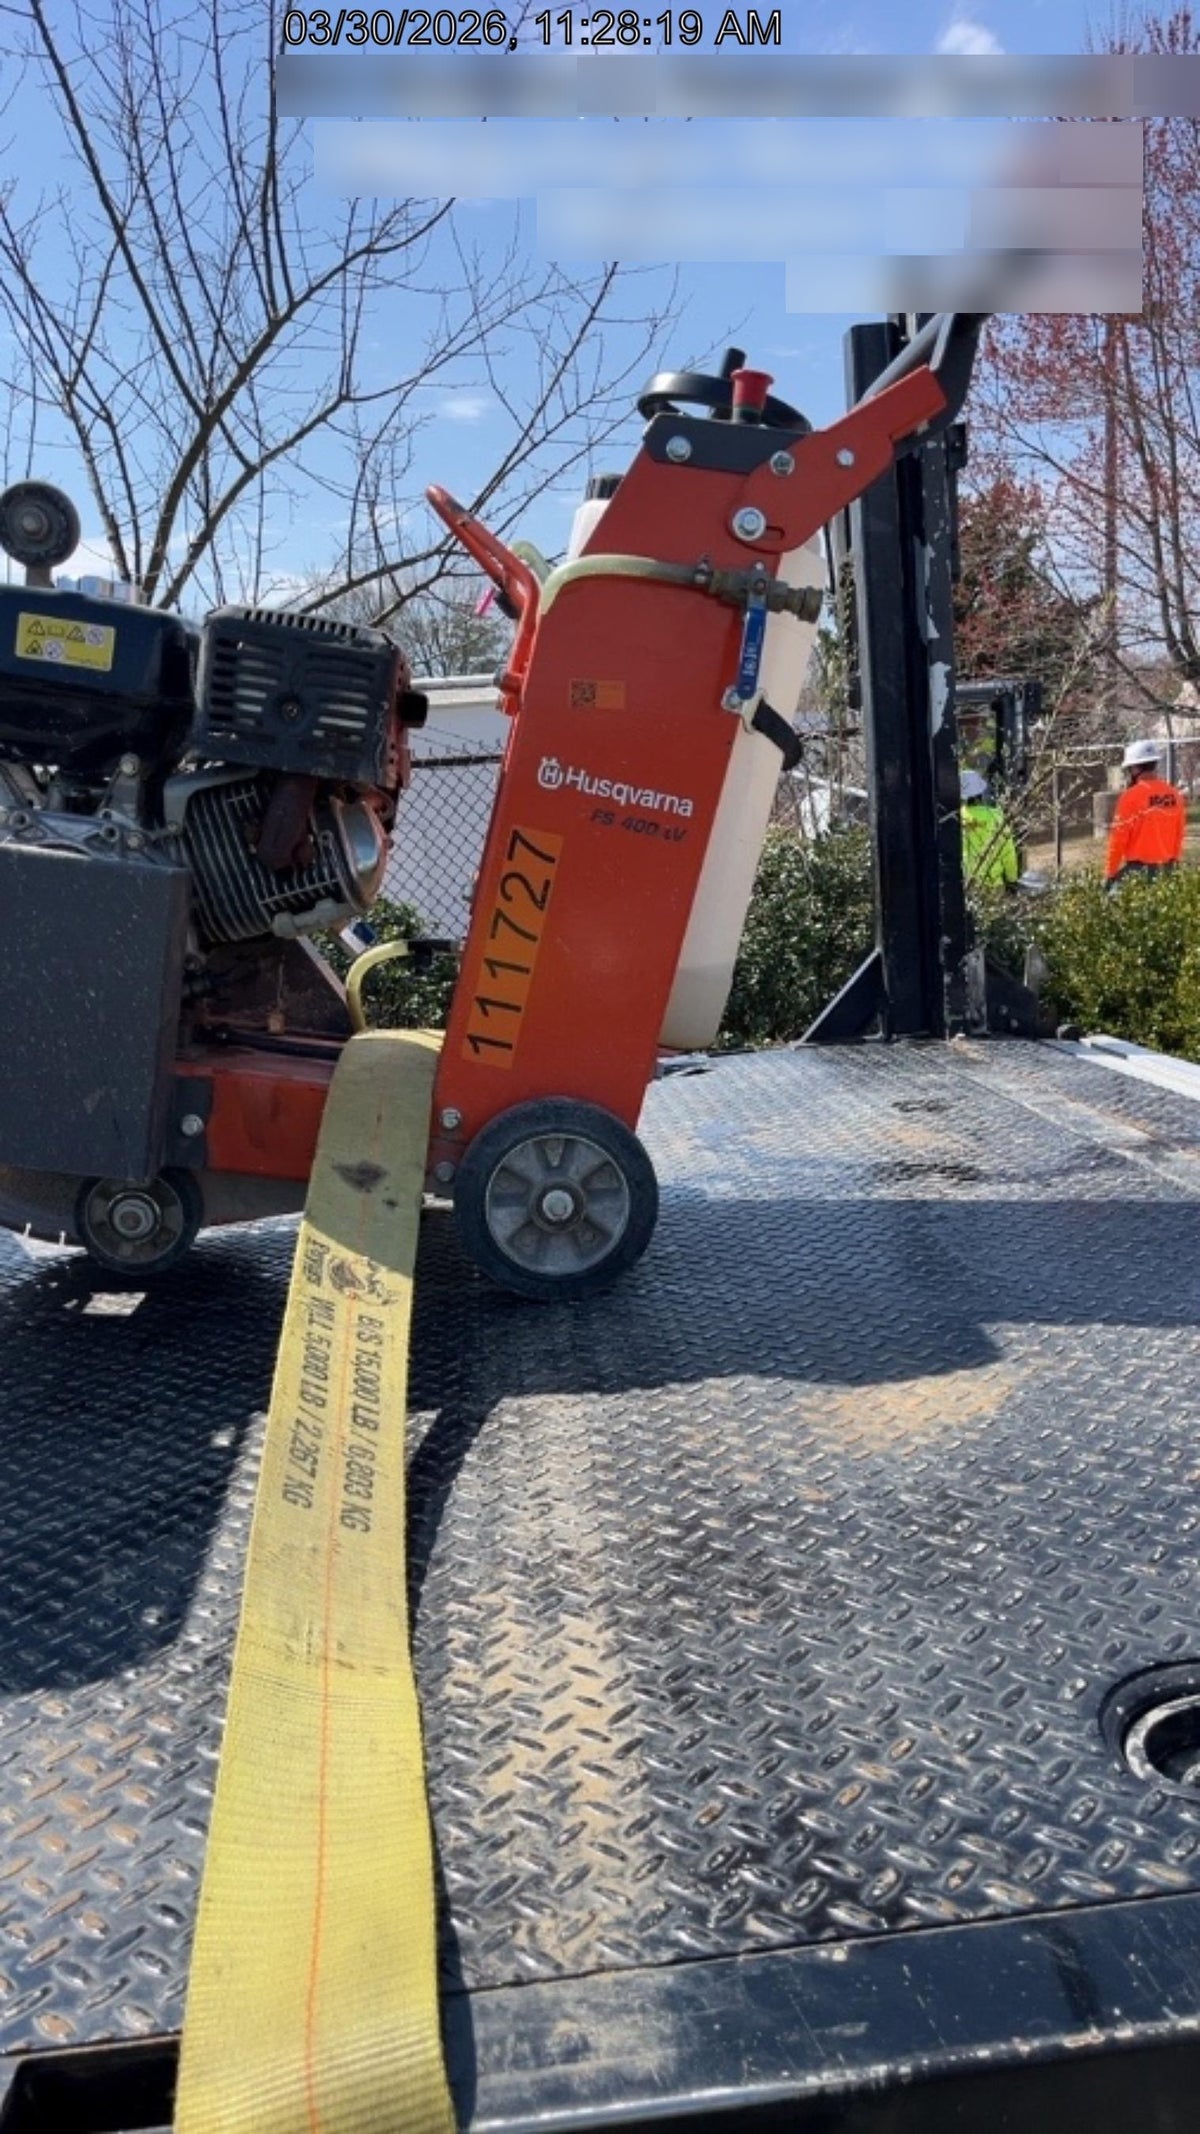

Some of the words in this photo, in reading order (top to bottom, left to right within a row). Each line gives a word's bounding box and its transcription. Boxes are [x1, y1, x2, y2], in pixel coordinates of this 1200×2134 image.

[565, 766, 694, 817] Husqvarna
[591, 809, 615, 826] FS
[622, 817, 660, 836] 400
[467, 829, 556, 1055] 111727
[302, 1332, 331, 1381] 5,000
[352, 1347, 382, 1404] 15,000
[300, 1379, 328, 1409] LB
[352, 1403, 380, 1431] LB
[289, 1417, 323, 1478] 2,267
[282, 1475, 314, 1509] KG
[340, 1500, 372, 1533] KG
